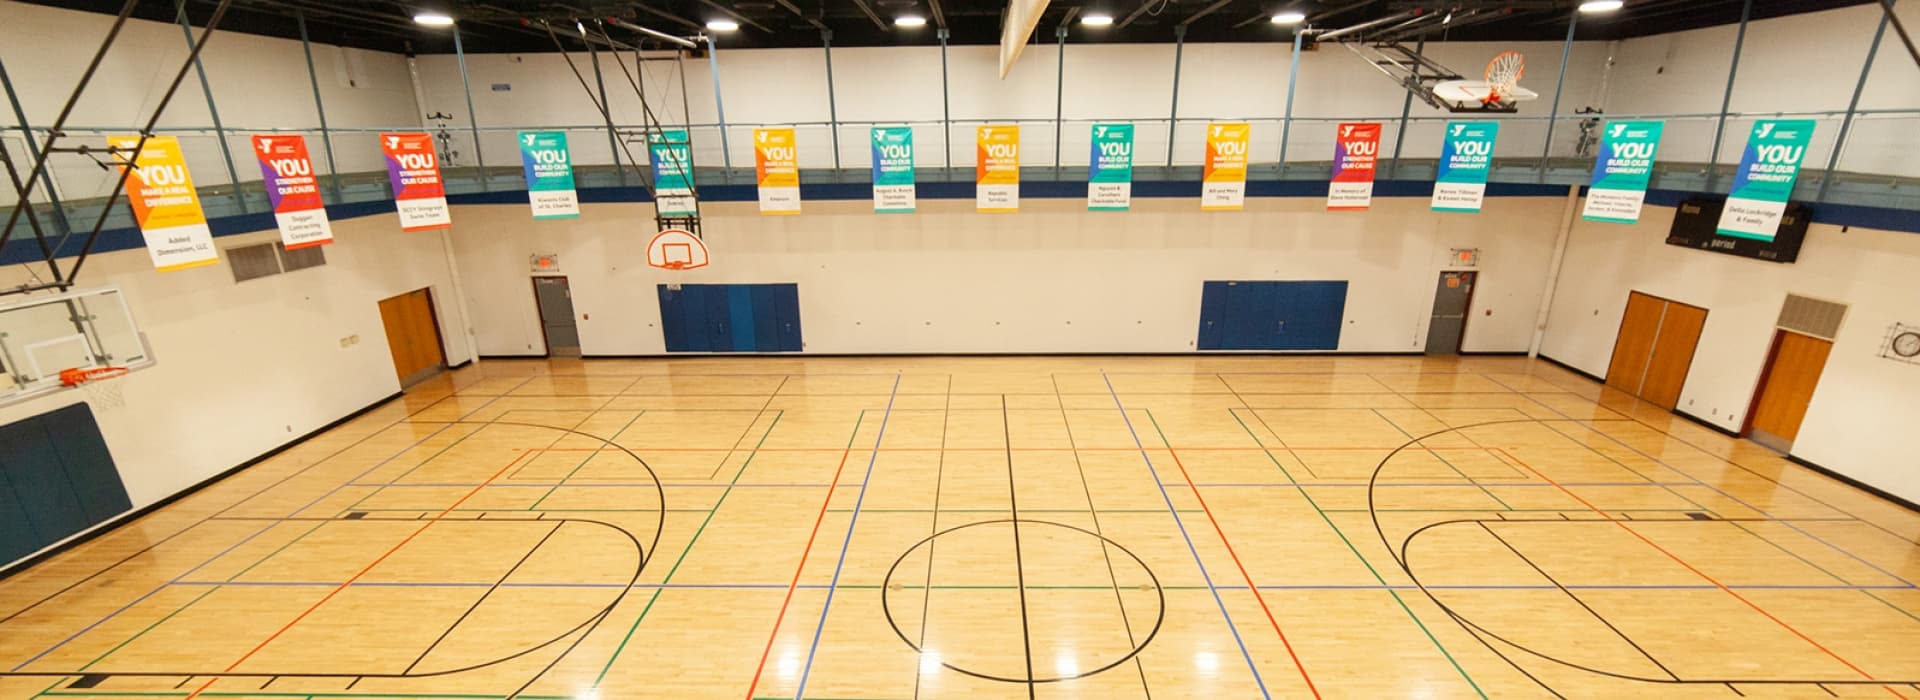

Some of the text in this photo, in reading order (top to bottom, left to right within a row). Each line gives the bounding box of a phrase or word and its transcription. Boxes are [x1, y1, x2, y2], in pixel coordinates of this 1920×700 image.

[764, 147, 793, 160] YOU
[880, 145, 910, 159] YOU
[986, 144, 1016, 158] YOU
[1099, 142, 1130, 156] YOU
[1216, 142, 1246, 155] YOU
[1345, 141, 1376, 155] YOU
[1454, 141, 1491, 155] YOU
[1612, 142, 1654, 158] YOU
[1758, 144, 1802, 164] YOU
[532, 150, 566, 164] YOU
[655, 148, 687, 162] YOU
[270, 158, 310, 177] YOU
[396, 154, 434, 170] YOU
[137, 165, 185, 185] YOU
[399, 170, 436, 178] STRENGTHEN
[1750, 164, 1796, 174] BUILD OUR
[274, 176, 314, 186] STRENGTHEN
[1748, 173, 1793, 182] COMMUNITY
[141, 187, 162, 196] MAKE
[278, 185, 316, 195] OUR CAUSE
[144, 196, 193, 208] DIFFERENCE
[1742, 217, 1762, 226] Family
[168, 236, 190, 245] Added
[196, 243, 209, 251] LLC
[1711, 239, 1736, 250] period
